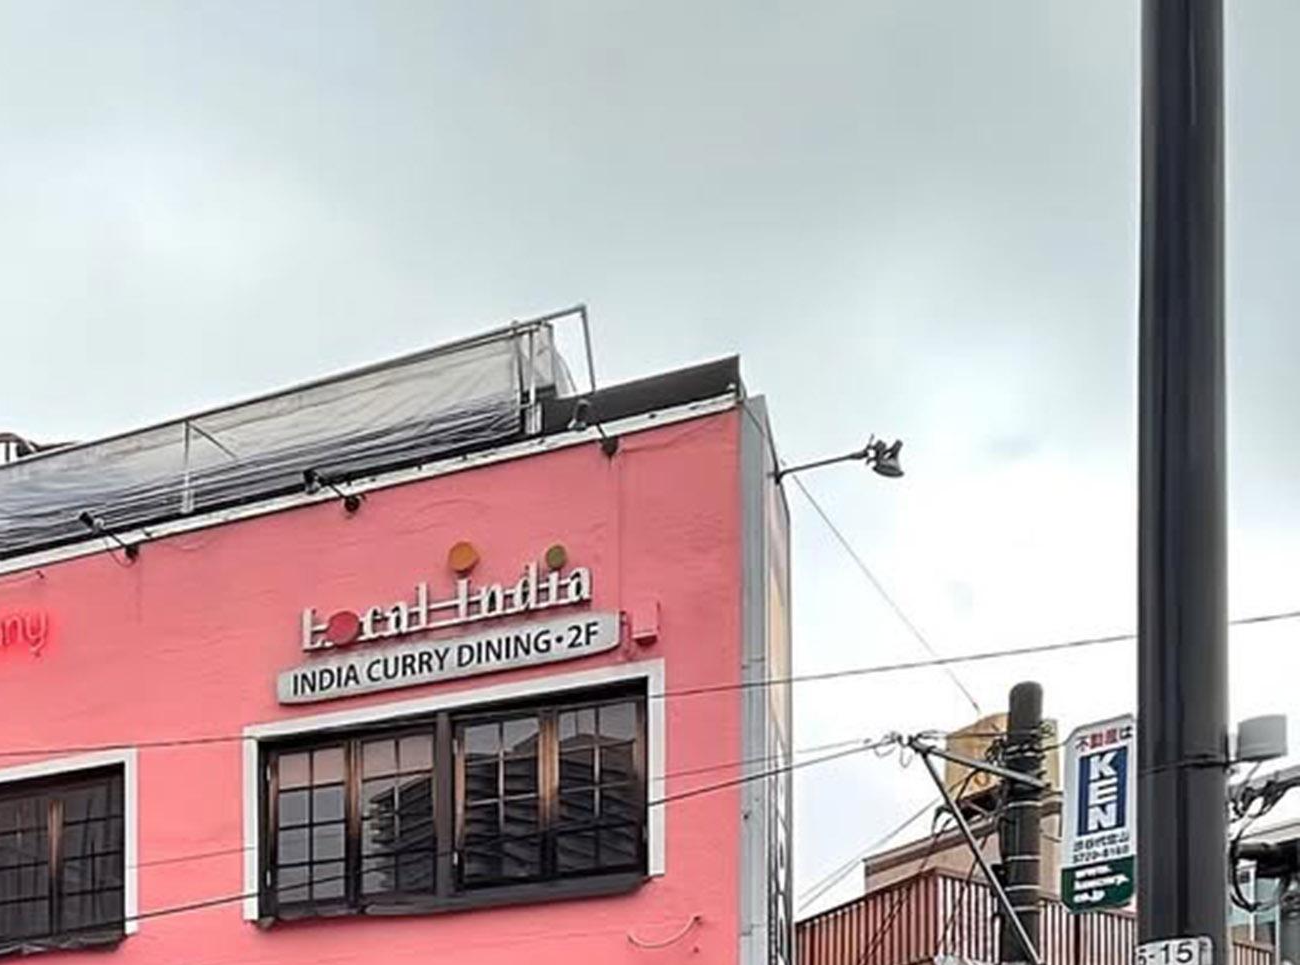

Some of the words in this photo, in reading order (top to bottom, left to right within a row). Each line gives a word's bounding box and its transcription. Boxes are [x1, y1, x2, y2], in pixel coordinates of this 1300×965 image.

[292, 664, 360, 696] INDIA
[366, 648, 450, 684] CURRY
[1087, 751, 1118, 832] KEN
